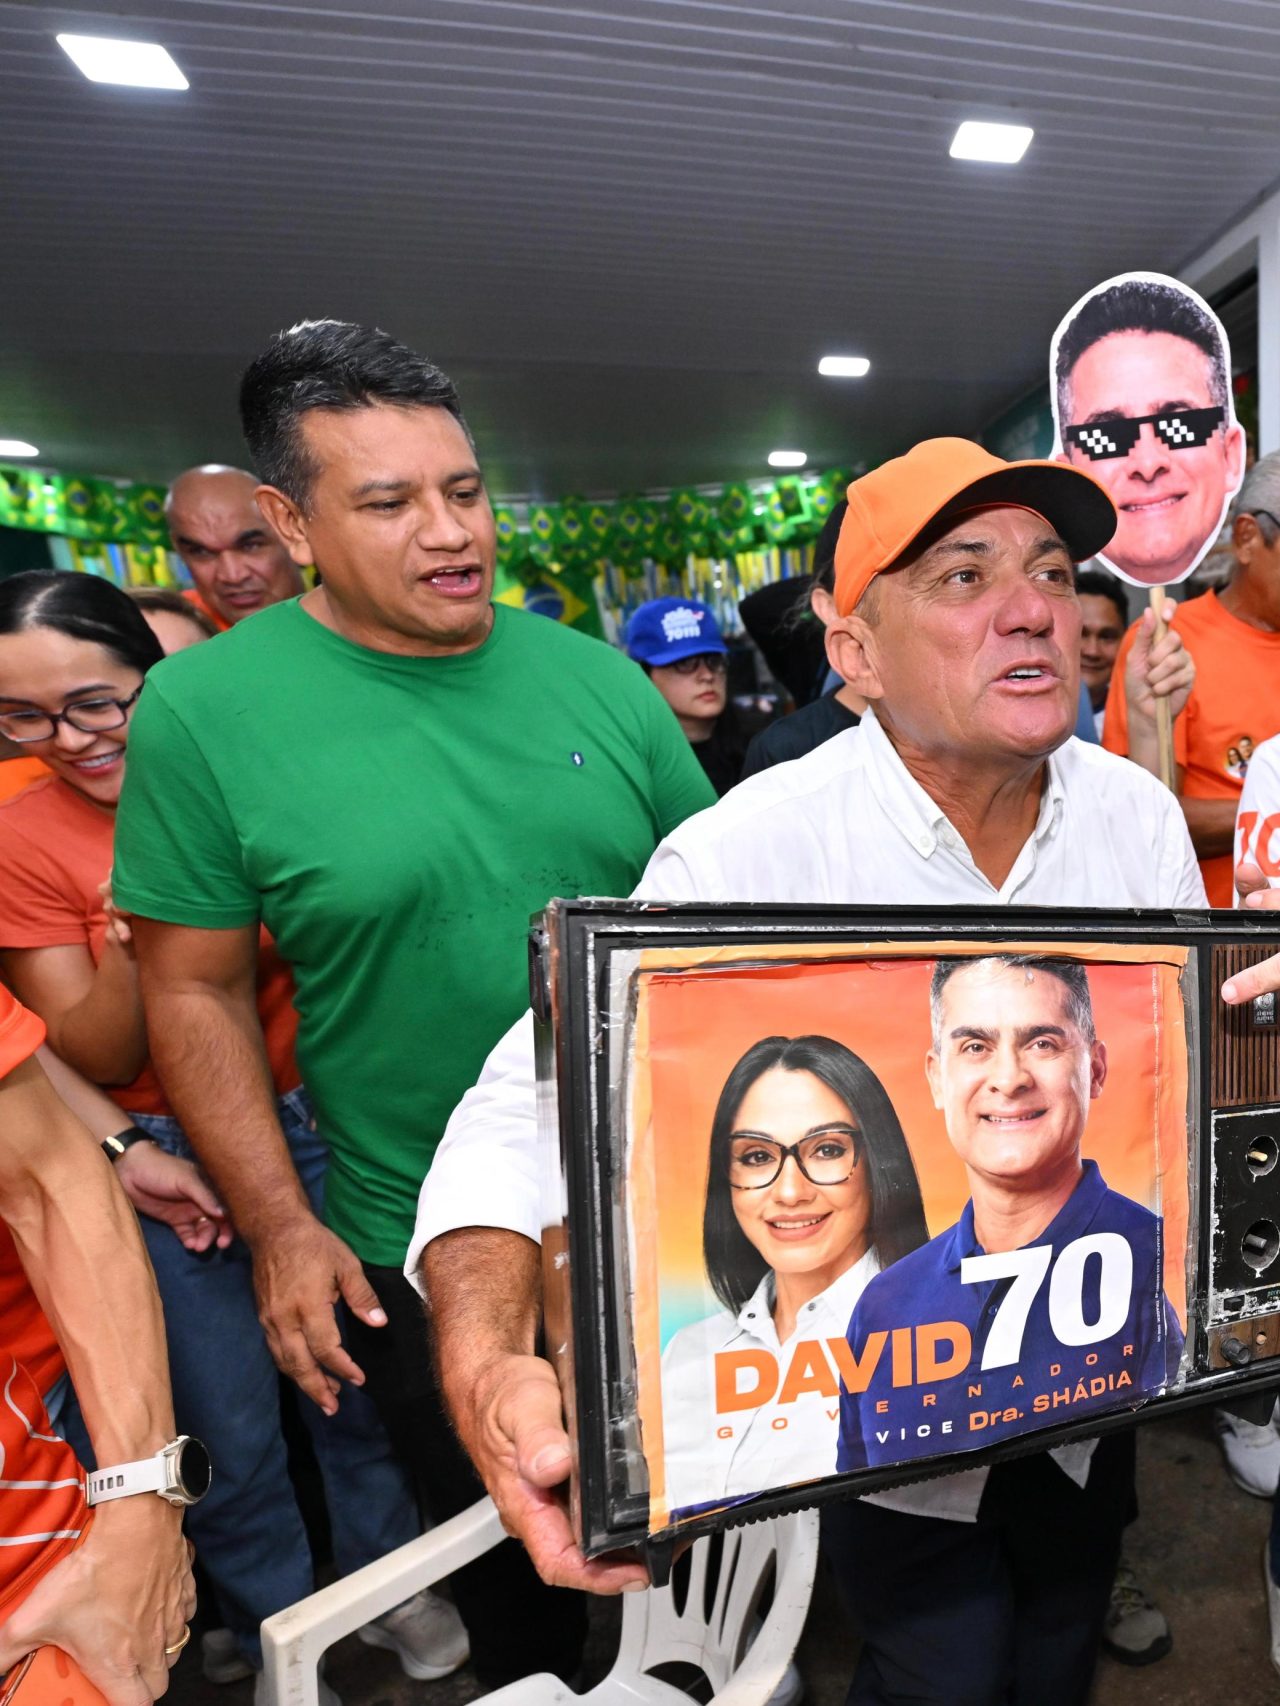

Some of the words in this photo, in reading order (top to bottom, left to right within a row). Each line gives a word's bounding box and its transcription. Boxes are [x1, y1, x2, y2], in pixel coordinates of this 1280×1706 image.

[714, 1321, 972, 1415] DAVID
[960, 1232, 1134, 1371] 70
[716, 1344, 1134, 1440] GOVERNADOR
[875, 1420, 953, 1444] VICE
[968, 1406, 1024, 1431] Dra.
[1032, 1370, 1133, 1413] SHÁDIA
